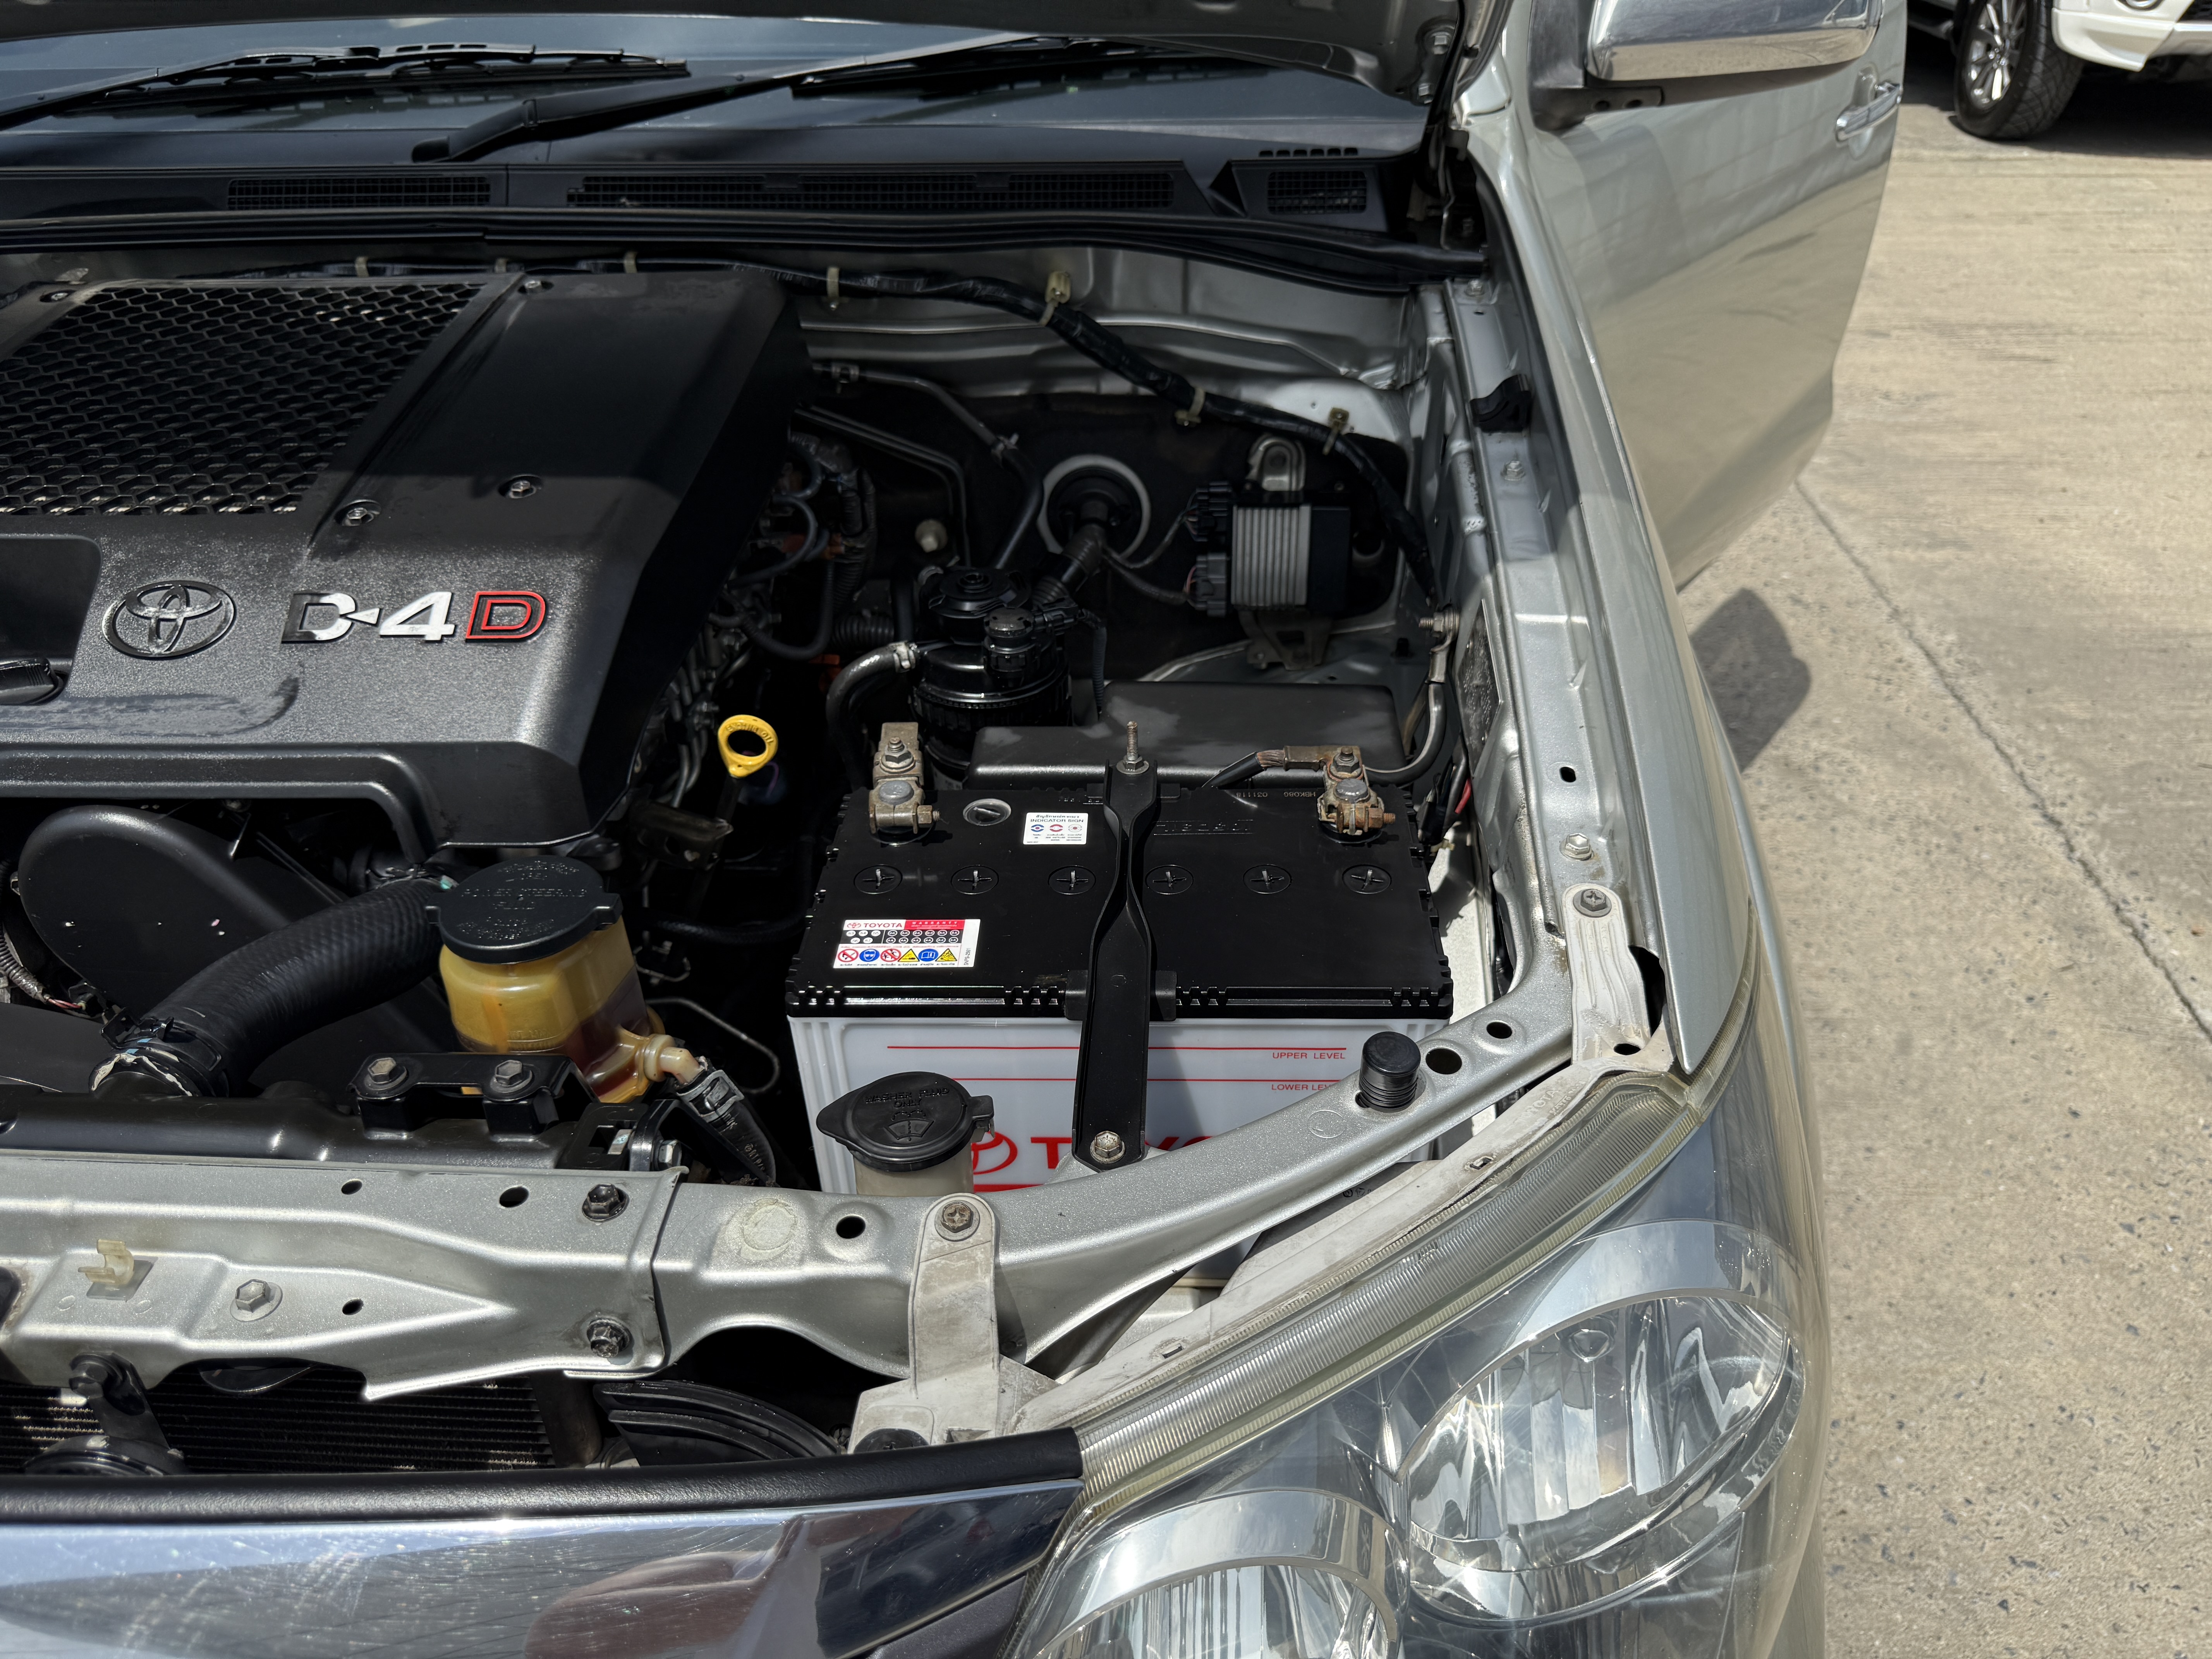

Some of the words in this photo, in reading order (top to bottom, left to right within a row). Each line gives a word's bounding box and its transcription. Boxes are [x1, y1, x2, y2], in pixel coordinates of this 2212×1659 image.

[865, 1092, 912, 1104] WASHER
[918, 1088, 950, 1099] FLUID
[893, 1099, 922, 1109] ONLY
